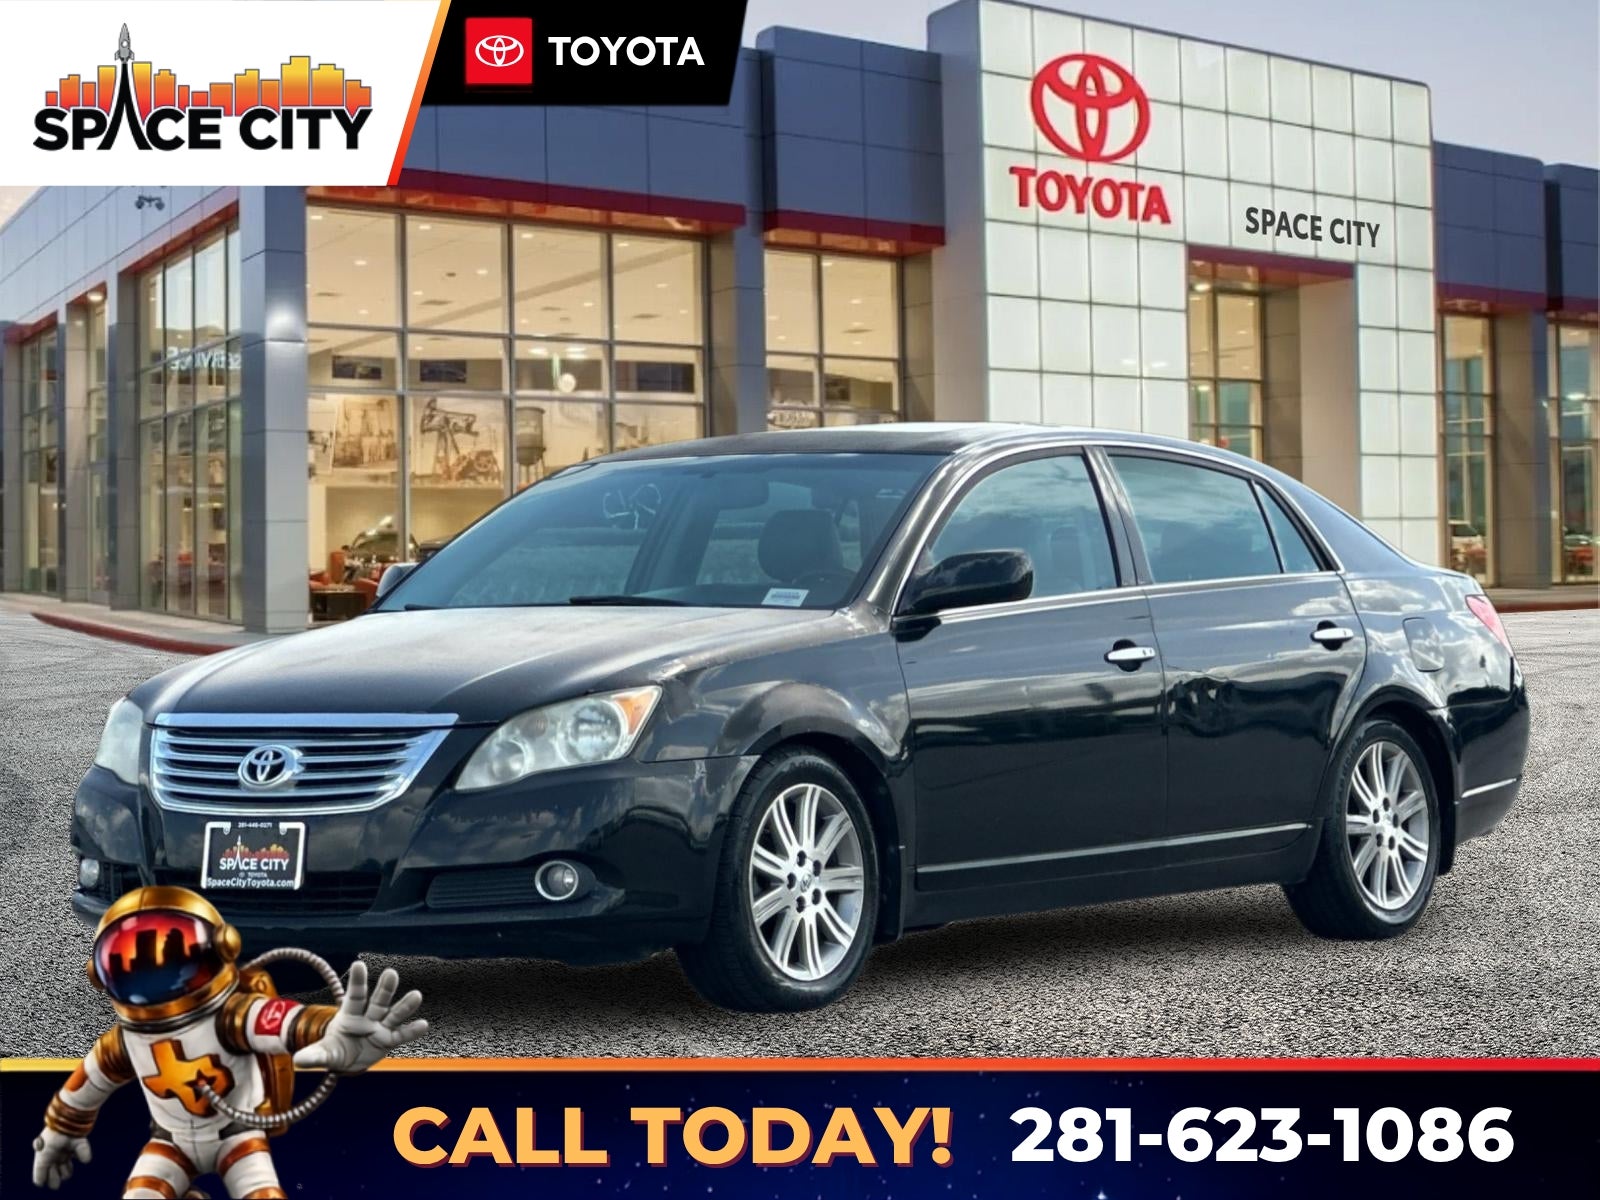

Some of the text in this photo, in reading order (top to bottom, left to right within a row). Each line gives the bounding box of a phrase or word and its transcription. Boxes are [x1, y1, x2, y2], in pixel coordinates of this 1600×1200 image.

[1009, 166, 1172, 225] TOYOTA
[1245, 206, 1381, 248] SPACE CITY
[219, 854, 290, 870] SPACE CITY
[207, 877, 294, 888] SpaceCityToyota.com
